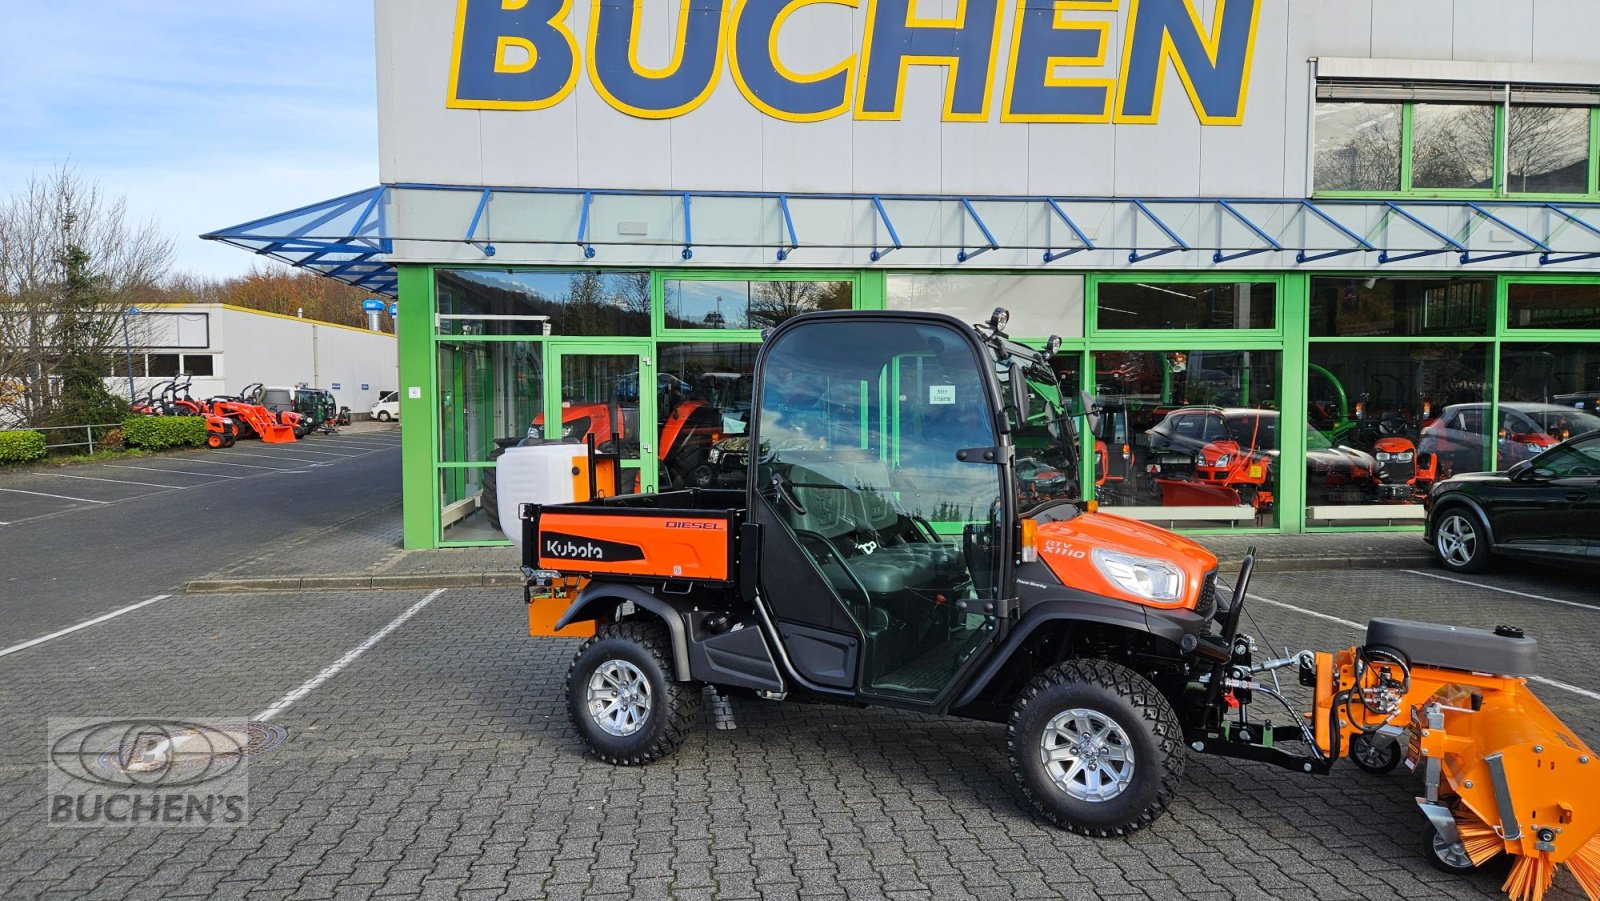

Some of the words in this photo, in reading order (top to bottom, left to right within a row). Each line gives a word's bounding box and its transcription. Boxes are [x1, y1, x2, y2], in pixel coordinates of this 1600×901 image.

[445, 0, 1261, 126] BUCHEN
[665, 520, 723, 531] DIESEL
[546, 540, 603, 559] Kubota
[1046, 541, 1071, 549] RTV
[1043, 548, 1086, 559] X1110
